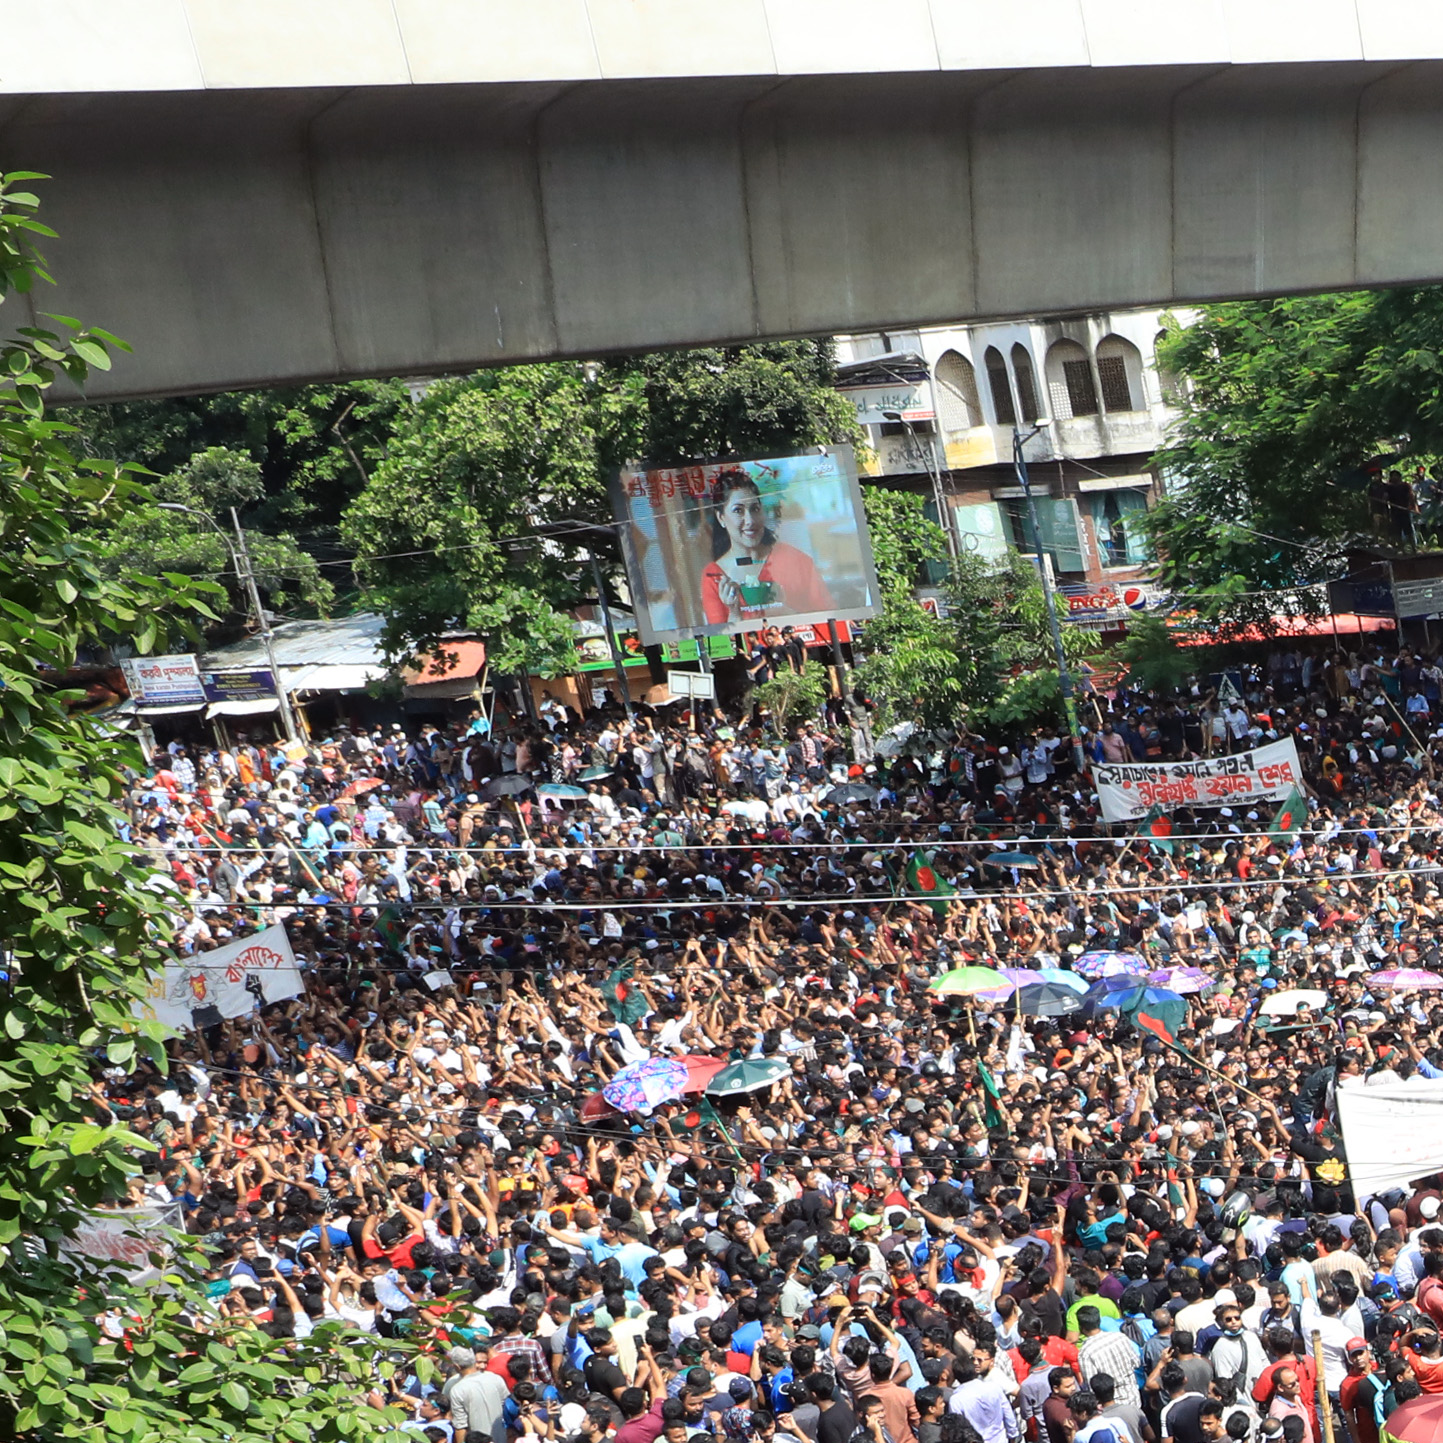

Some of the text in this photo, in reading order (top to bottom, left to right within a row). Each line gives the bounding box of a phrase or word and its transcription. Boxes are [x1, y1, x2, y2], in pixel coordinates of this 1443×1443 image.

[1205, 775, 1253, 796] হয়নি
[1258, 761, 1295, 788] শেষ
[1217, 752, 1254, 775] পতন
[225, 946, 284, 983] বাংলাদেশ
